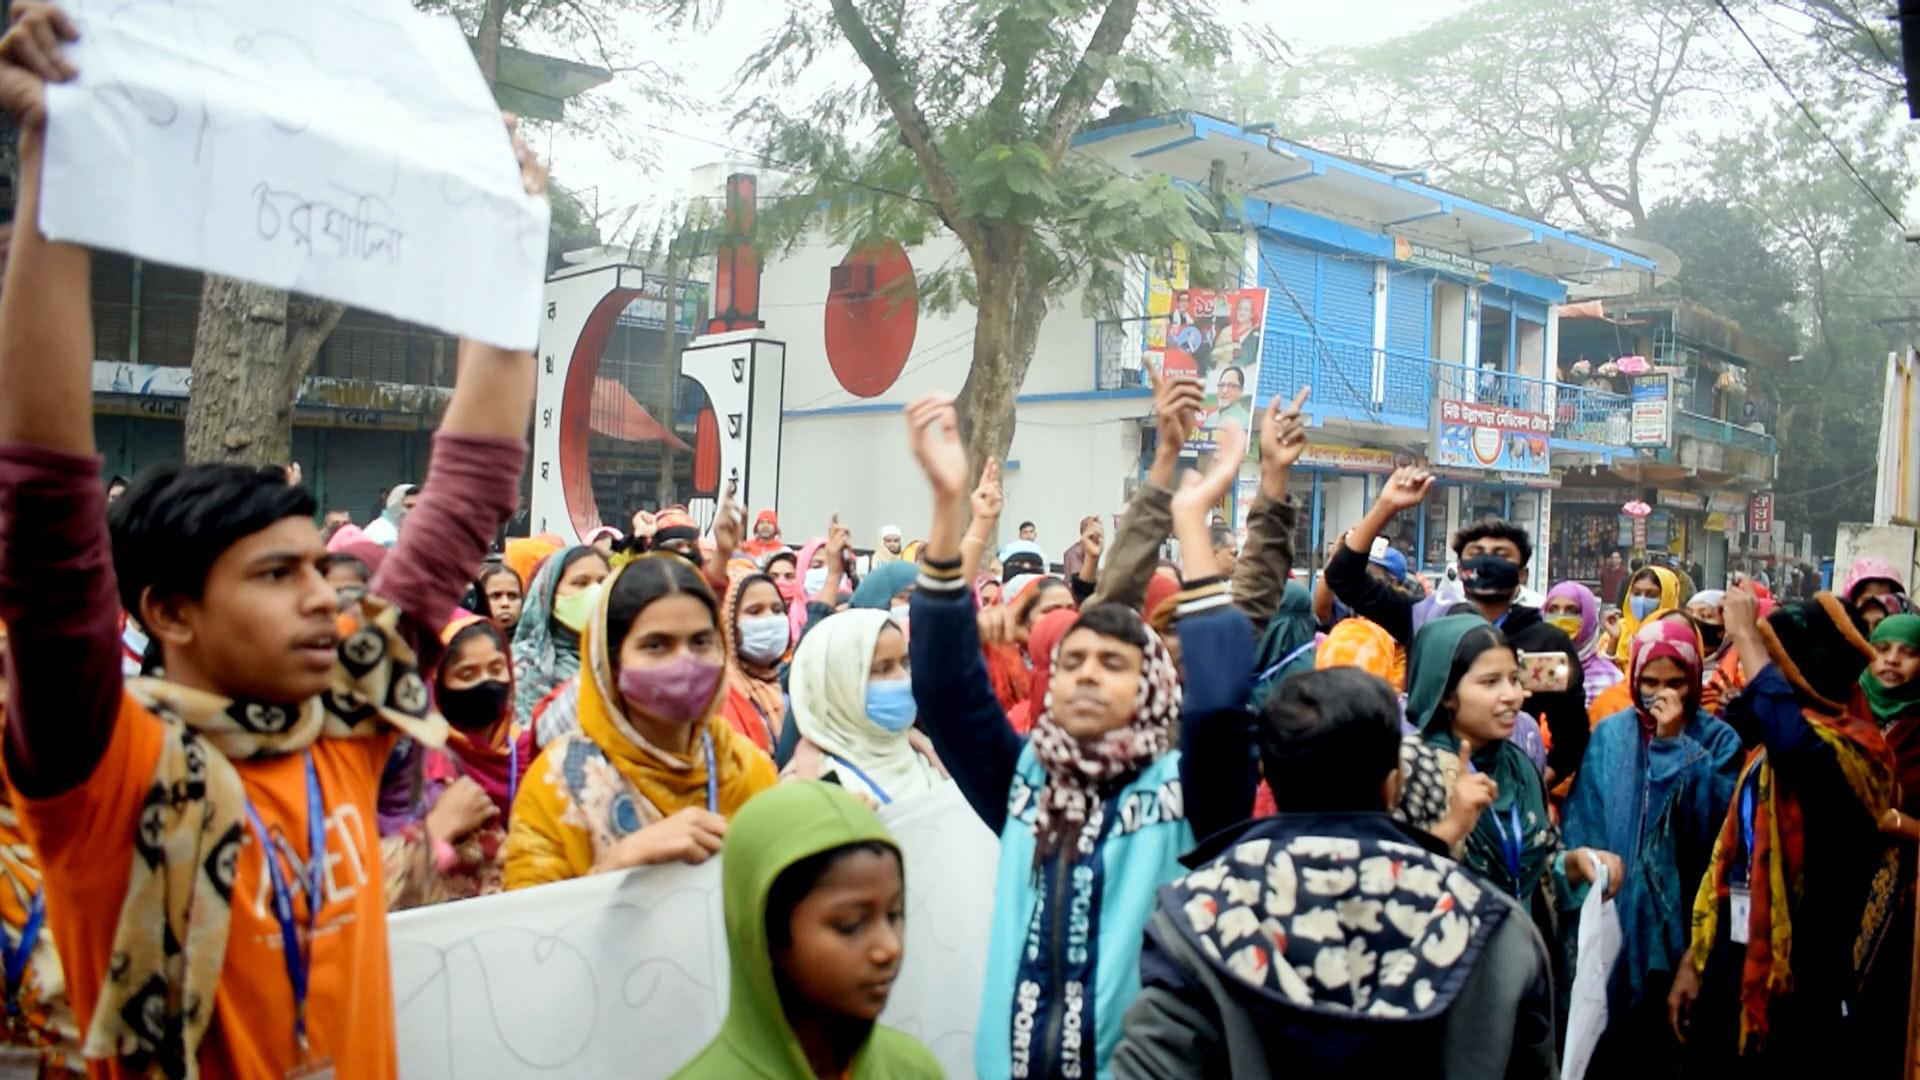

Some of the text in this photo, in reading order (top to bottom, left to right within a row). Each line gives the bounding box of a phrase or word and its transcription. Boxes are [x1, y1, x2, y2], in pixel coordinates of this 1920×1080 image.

[1067, 865, 1094, 964] SPORTS
[1012, 980, 1041, 1079] SPORTS
[1061, 980, 1084, 1079] SPORTS
